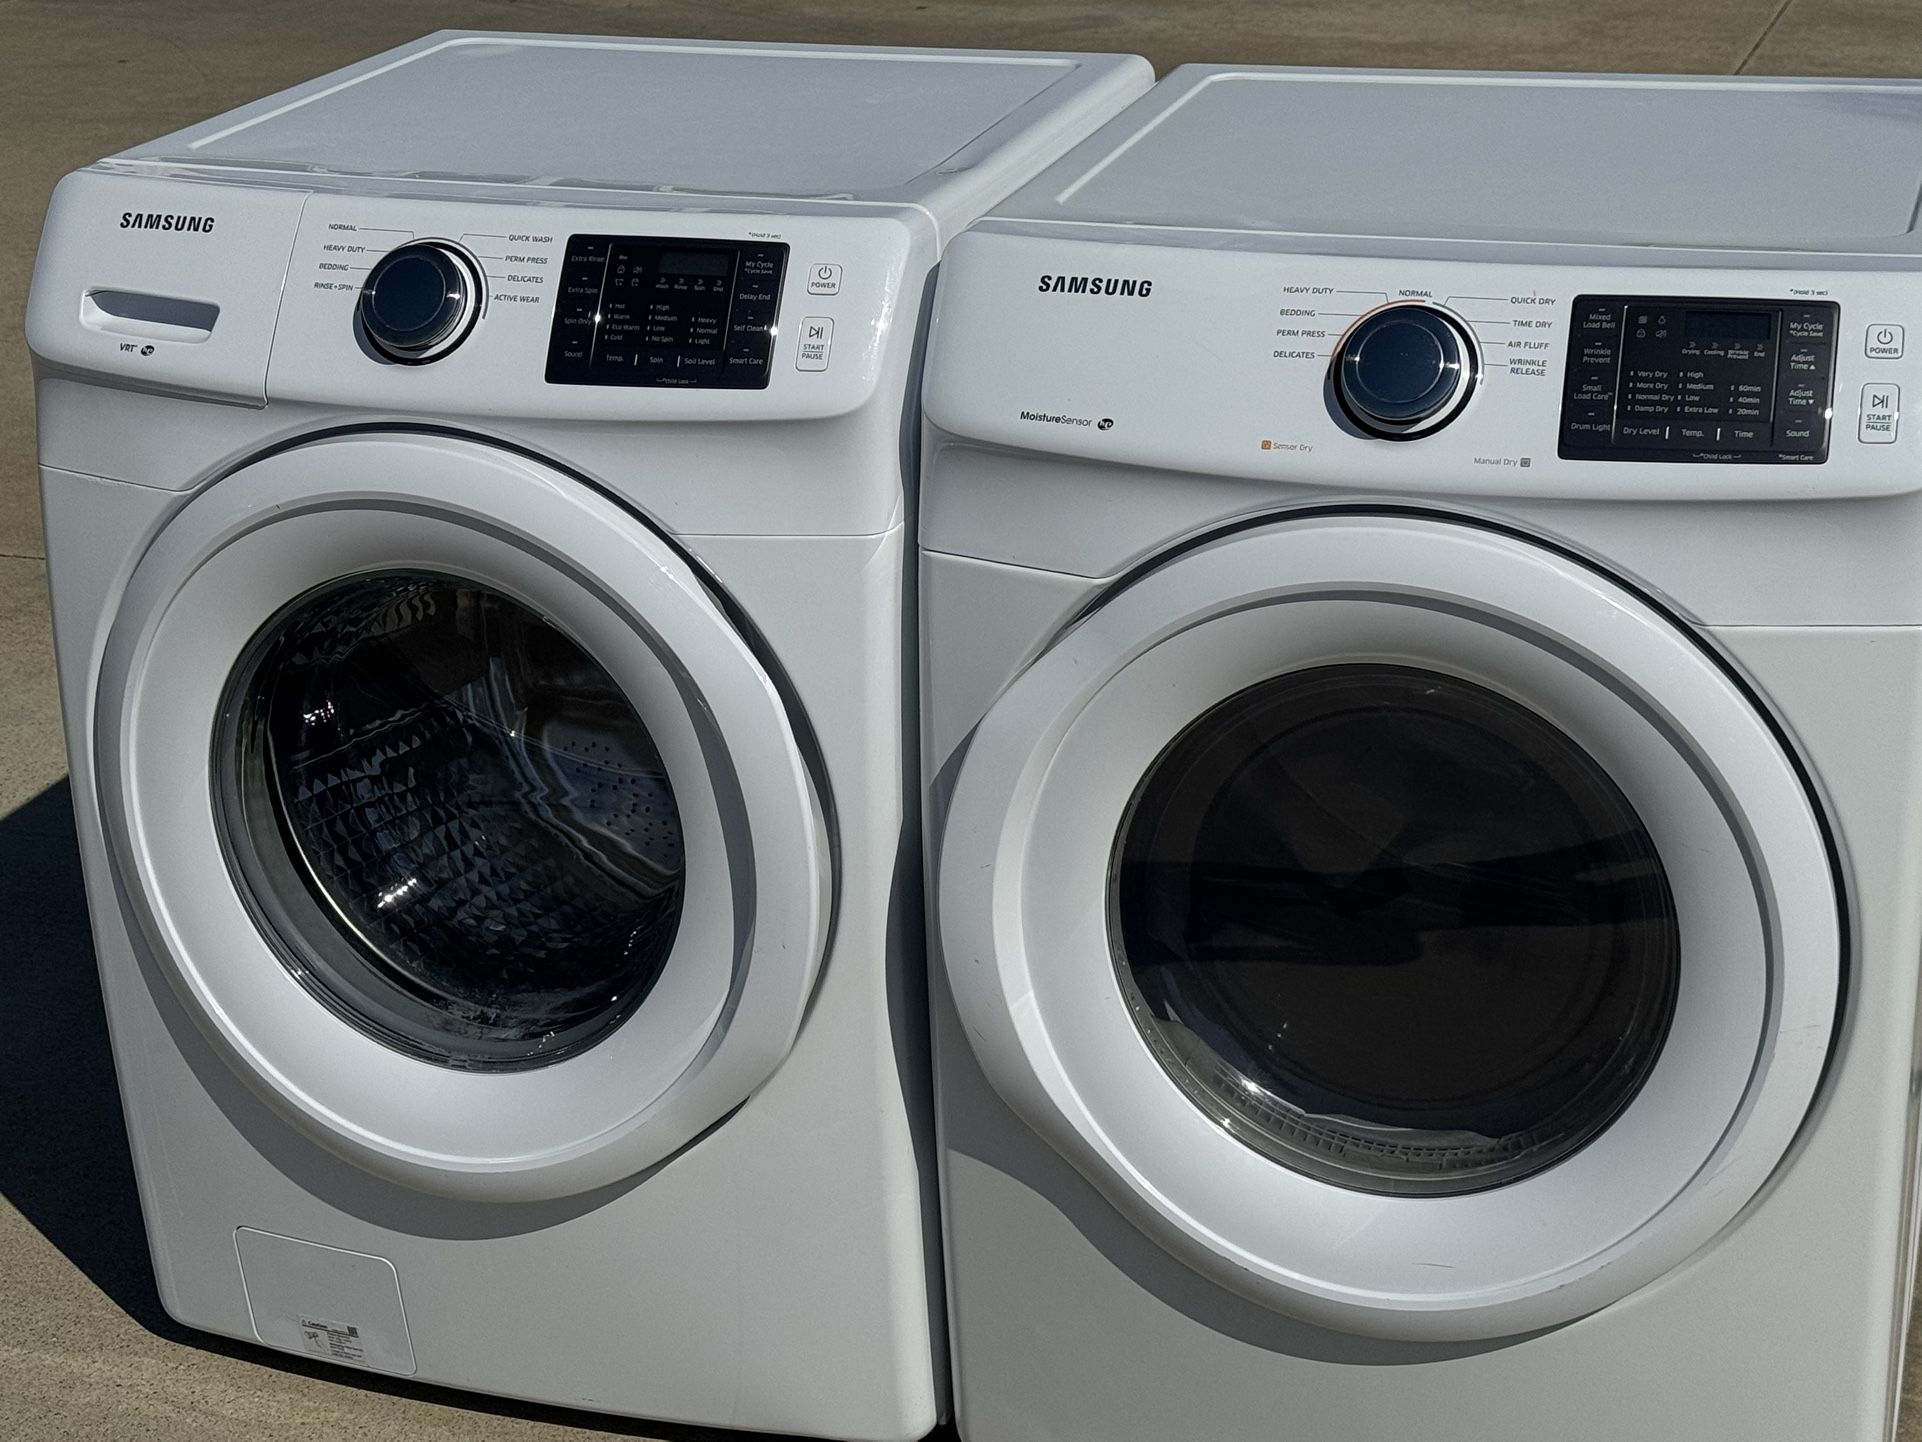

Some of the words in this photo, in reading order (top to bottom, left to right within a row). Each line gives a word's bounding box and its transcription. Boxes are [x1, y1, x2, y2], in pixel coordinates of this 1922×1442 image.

[120, 212, 215, 233] SAMSUNG
[509, 234, 530, 242] QUICK
[505, 255, 525, 263] PERM
[319, 263, 349, 271] BEDDING
[507, 275, 544, 283] DELICATES
[314, 282, 353, 291] RINSE+SPIN
[1038, 275, 1152, 297] SAMSUNG
[494, 294, 517, 302] ACTIVE
[1399, 290, 1432, 298] NORMAL
[1280, 309, 1316, 317] BEDDING
[1513, 320, 1532, 328] TIME
[1790, 322, 1801, 330] My
[1803, 322, 1823, 331] Cycle
[1277, 329, 1300, 337] PERM
[1302, 330, 1326, 338] PRESS
[1524, 342, 1550, 350] FLUFF
[802, 352, 823, 360] PAUSE
[1273, 351, 1315, 359] DELICATES
[1791, 354, 1815, 362] Adjust
[698, 358, 715, 366] Level
[1509, 358, 1547, 367] WRINKLE
[1790, 362, 1808, 370] Time
[1510, 367, 1546, 376] RELEASE
[1789, 389, 1813, 397] Adjust
[1020, 411, 1092, 427] MoistureSensor
[1592, 423, 1610, 431] Light
[1623, 427, 1638, 435] Dry
[1682, 429, 1704, 437] Temp.
[1786, 430, 1809, 438] Sound
[1300, 444, 1313, 452] Dry
[1474, 457, 1501, 465] Manual
[1503, 458, 1517, 467] Dry
